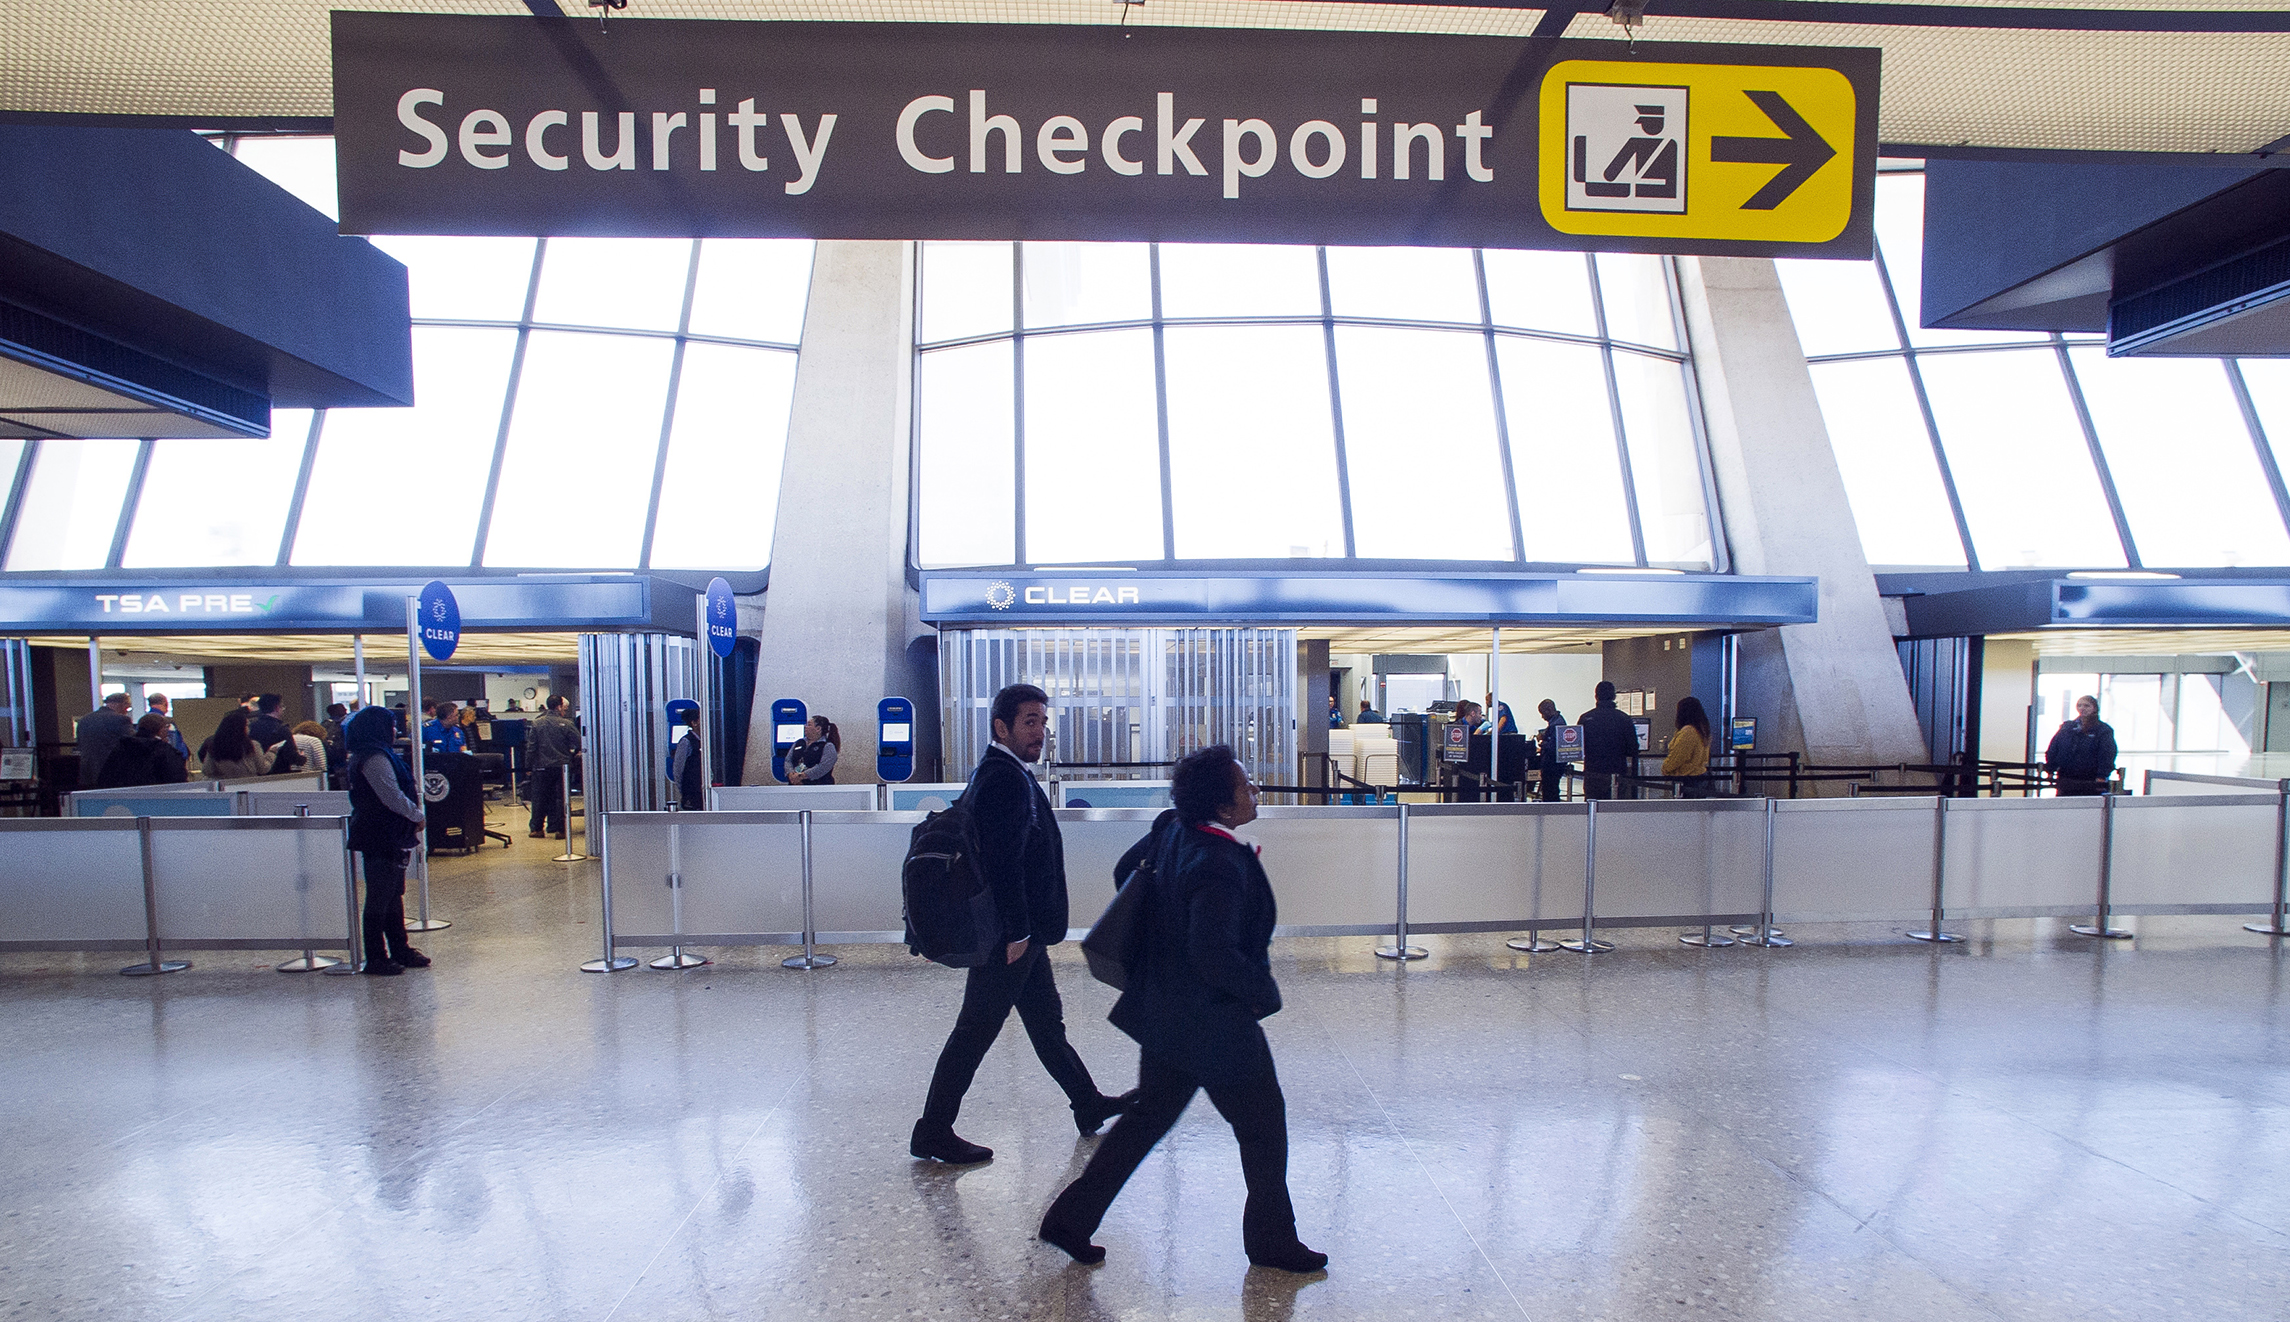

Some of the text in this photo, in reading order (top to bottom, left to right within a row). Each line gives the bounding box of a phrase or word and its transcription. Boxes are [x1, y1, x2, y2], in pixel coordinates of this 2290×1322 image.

[397, 88, 1495, 199] Security Checkpoint
[96, 594, 170, 613] TSA
[1025, 586, 1140, 604] CLEAR
[425, 628, 455, 641] CLEAR
[711, 624, 733, 638] CLEAR
